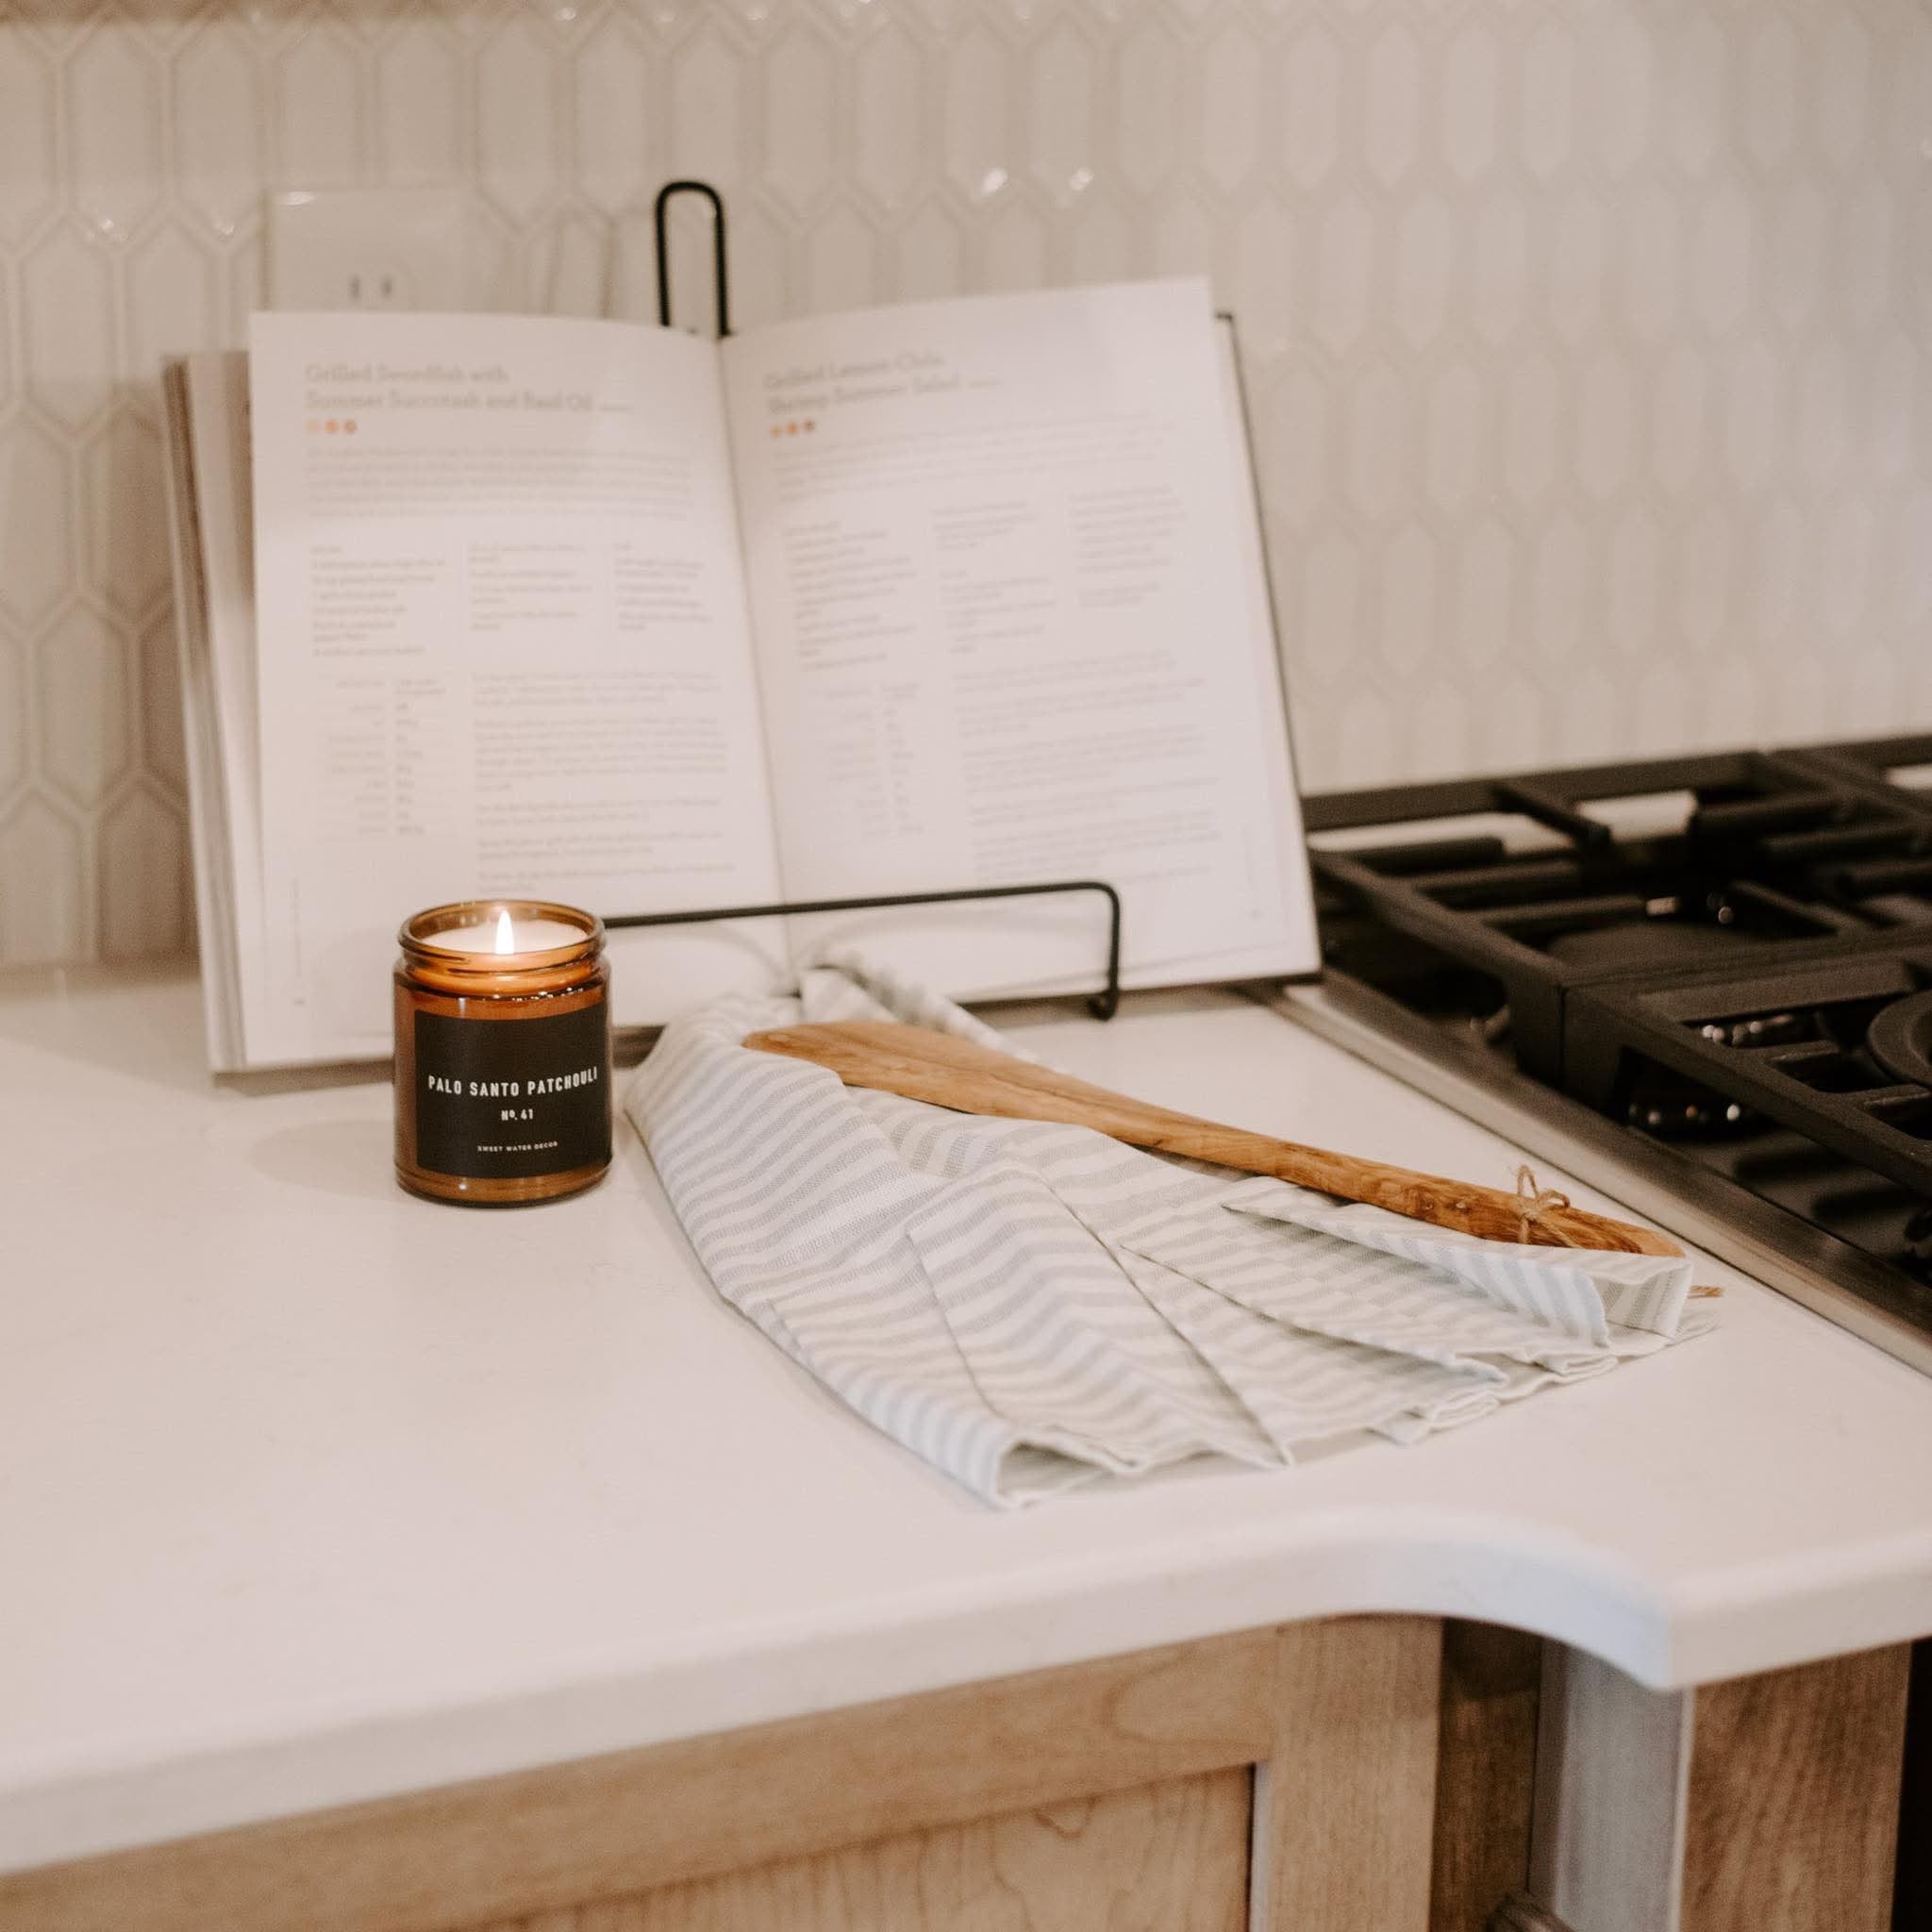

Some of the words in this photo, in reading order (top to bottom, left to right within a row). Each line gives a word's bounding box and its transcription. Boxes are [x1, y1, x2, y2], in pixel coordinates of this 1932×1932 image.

[428, 1074, 462, 1095] PALO
[469, 1081, 520, 1097] SANTO
[526, 1066, 598, 1095] PATCHOULI
[476, 1144, 504, 1153] SWEET
[506, 1143, 532, 1152] WATER
[534, 1140, 558, 1150] DECOR
